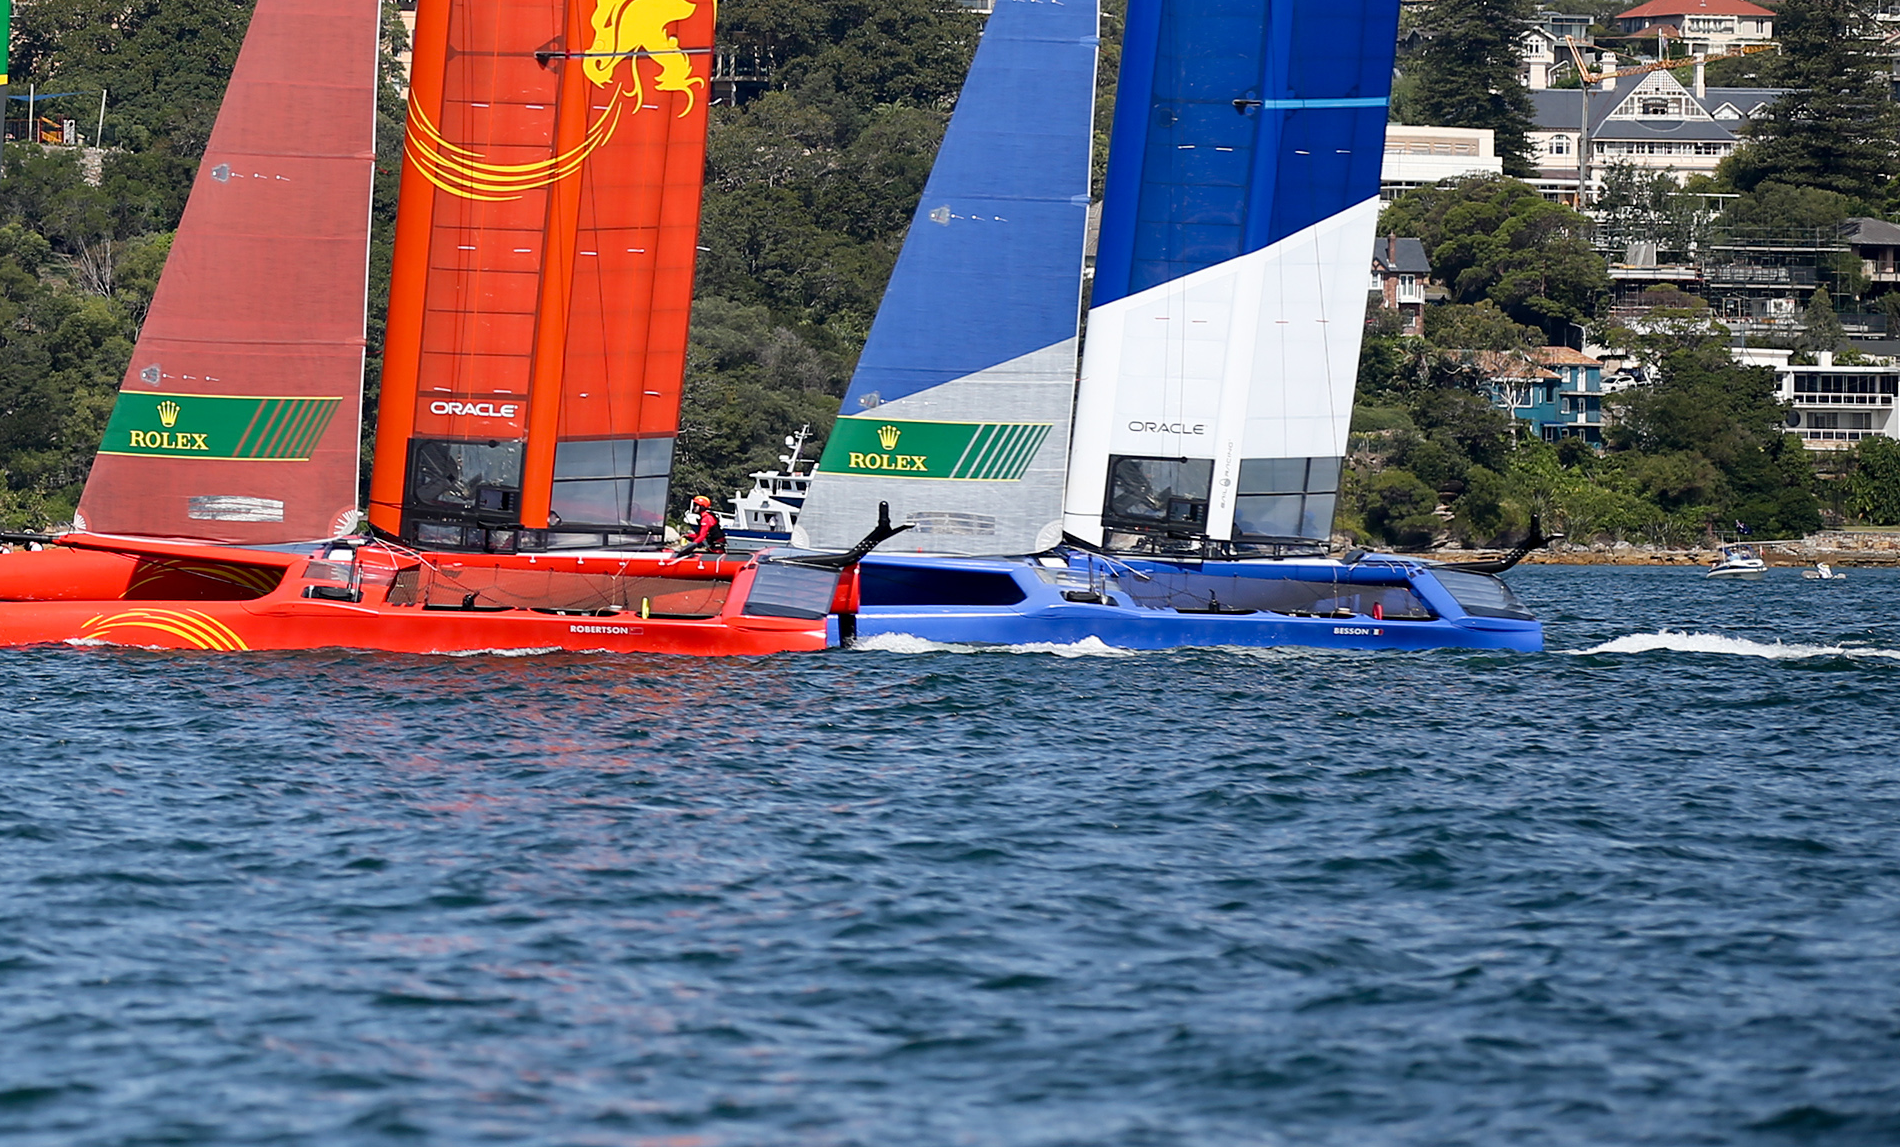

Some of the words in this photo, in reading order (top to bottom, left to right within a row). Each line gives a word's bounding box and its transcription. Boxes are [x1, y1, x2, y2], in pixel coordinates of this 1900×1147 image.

[430, 401, 519, 418] ORACLE
[1128, 420, 1205, 435] ORACLE
[129, 430, 209, 450] ROLEX
[849, 452, 928, 472] ROLEX
[570, 625, 628, 634] ROBERTSON
[1333, 627, 1369, 635] BESSON
